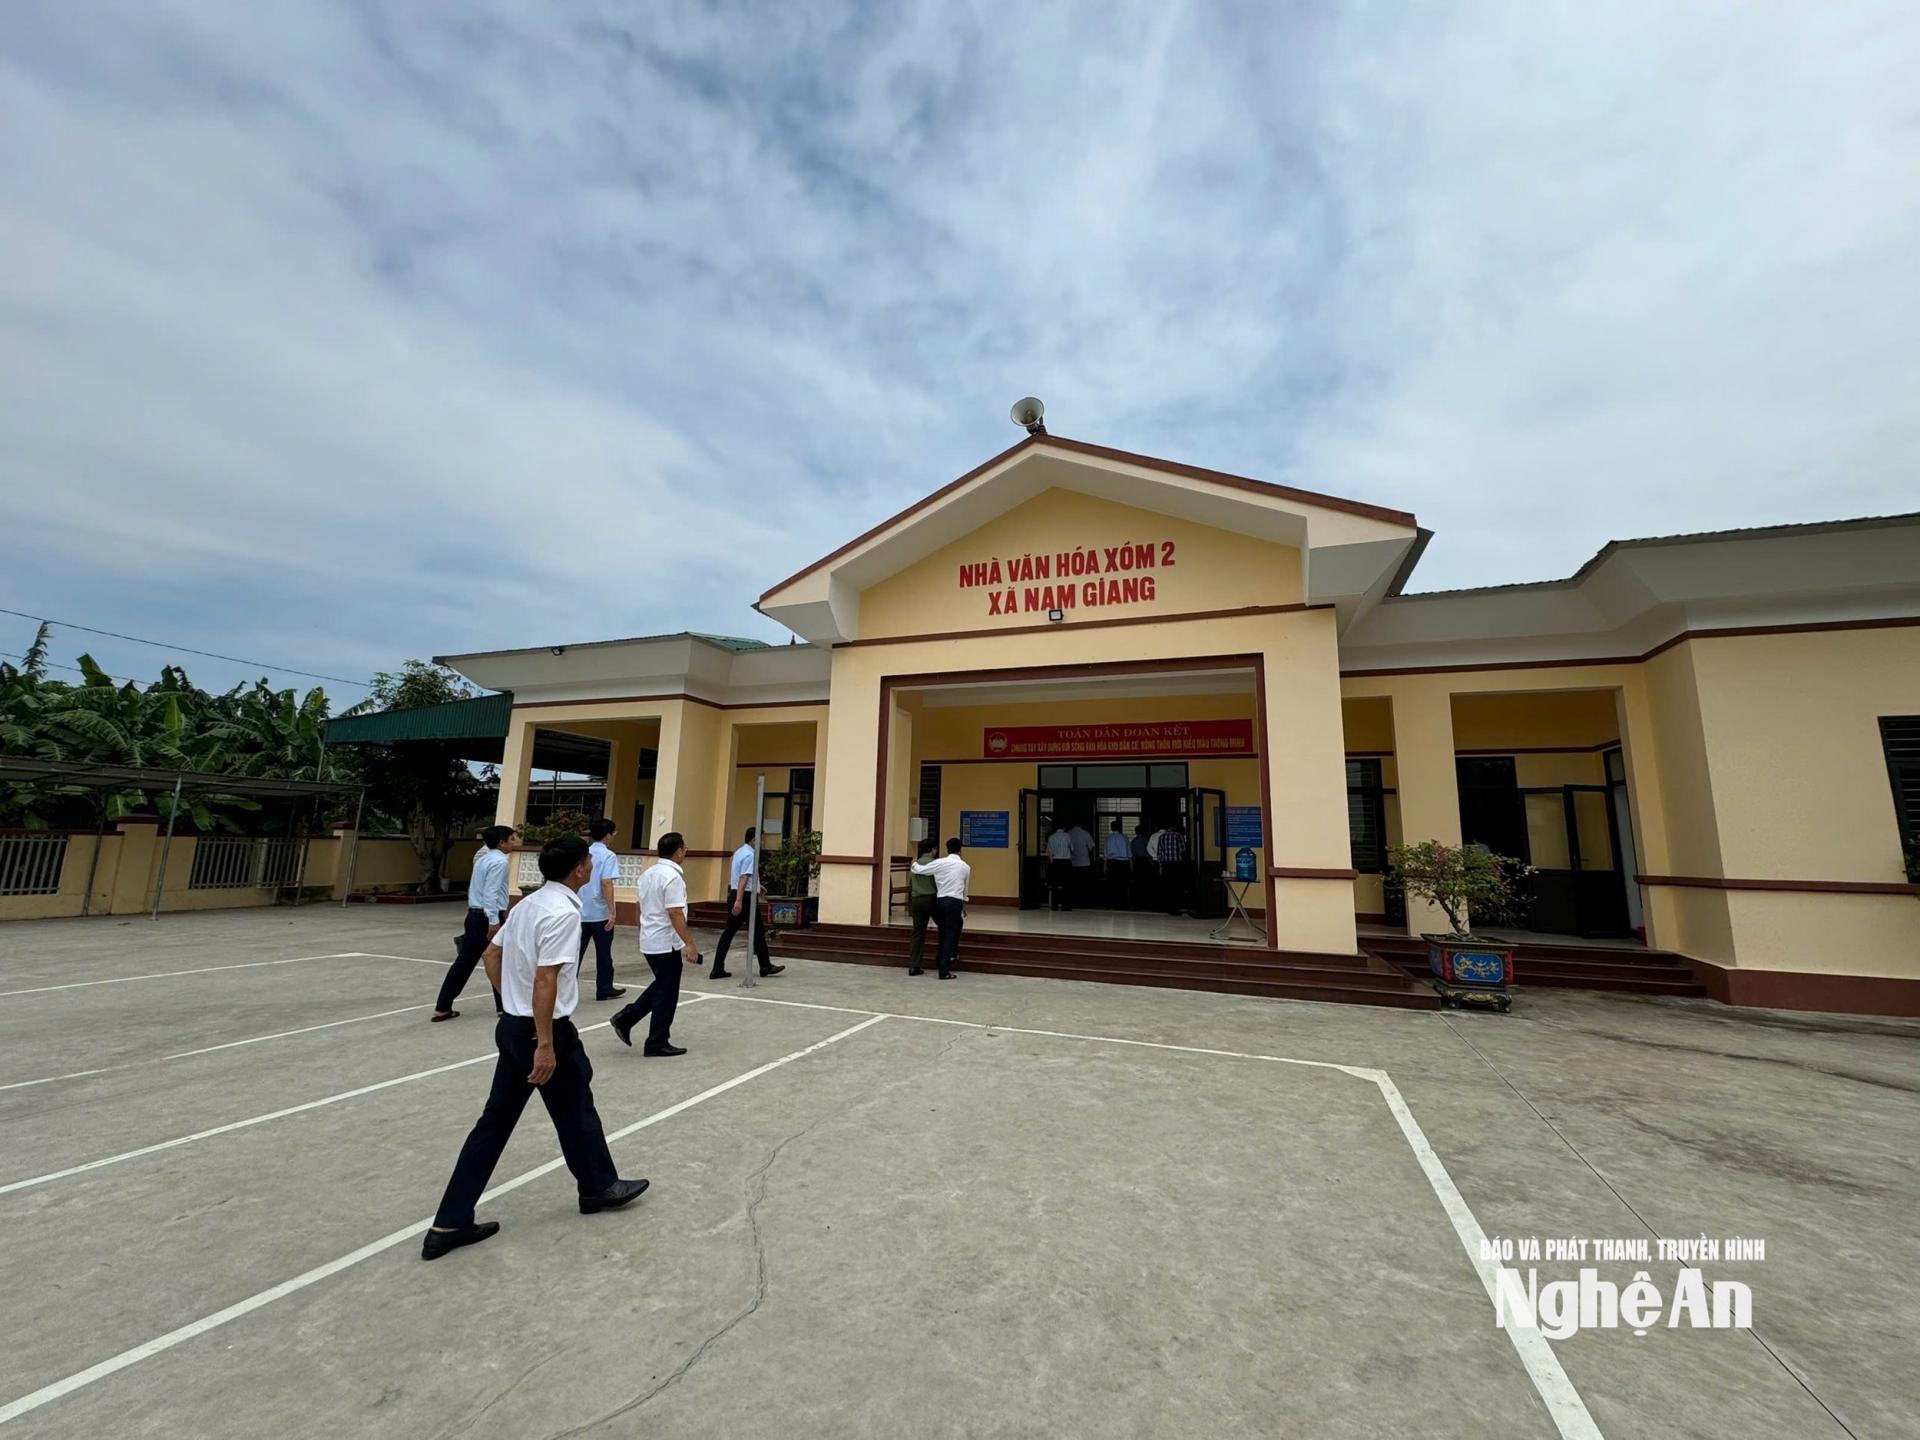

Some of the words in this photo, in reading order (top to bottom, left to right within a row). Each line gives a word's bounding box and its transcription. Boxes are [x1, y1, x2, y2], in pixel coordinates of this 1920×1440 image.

[960, 557, 1002, 588] NHÀ
[1007, 553, 1050, 582] VĂN
[1056, 546, 1100, 577] HÓA
[1104, 541, 1155, 573] XÓM
[1161, 541, 1175, 566] 2
[988, 586, 1018, 616] XÃ
[1024, 584, 1076, 612] NAM
[1164, 724, 1191, 736] KẾT
